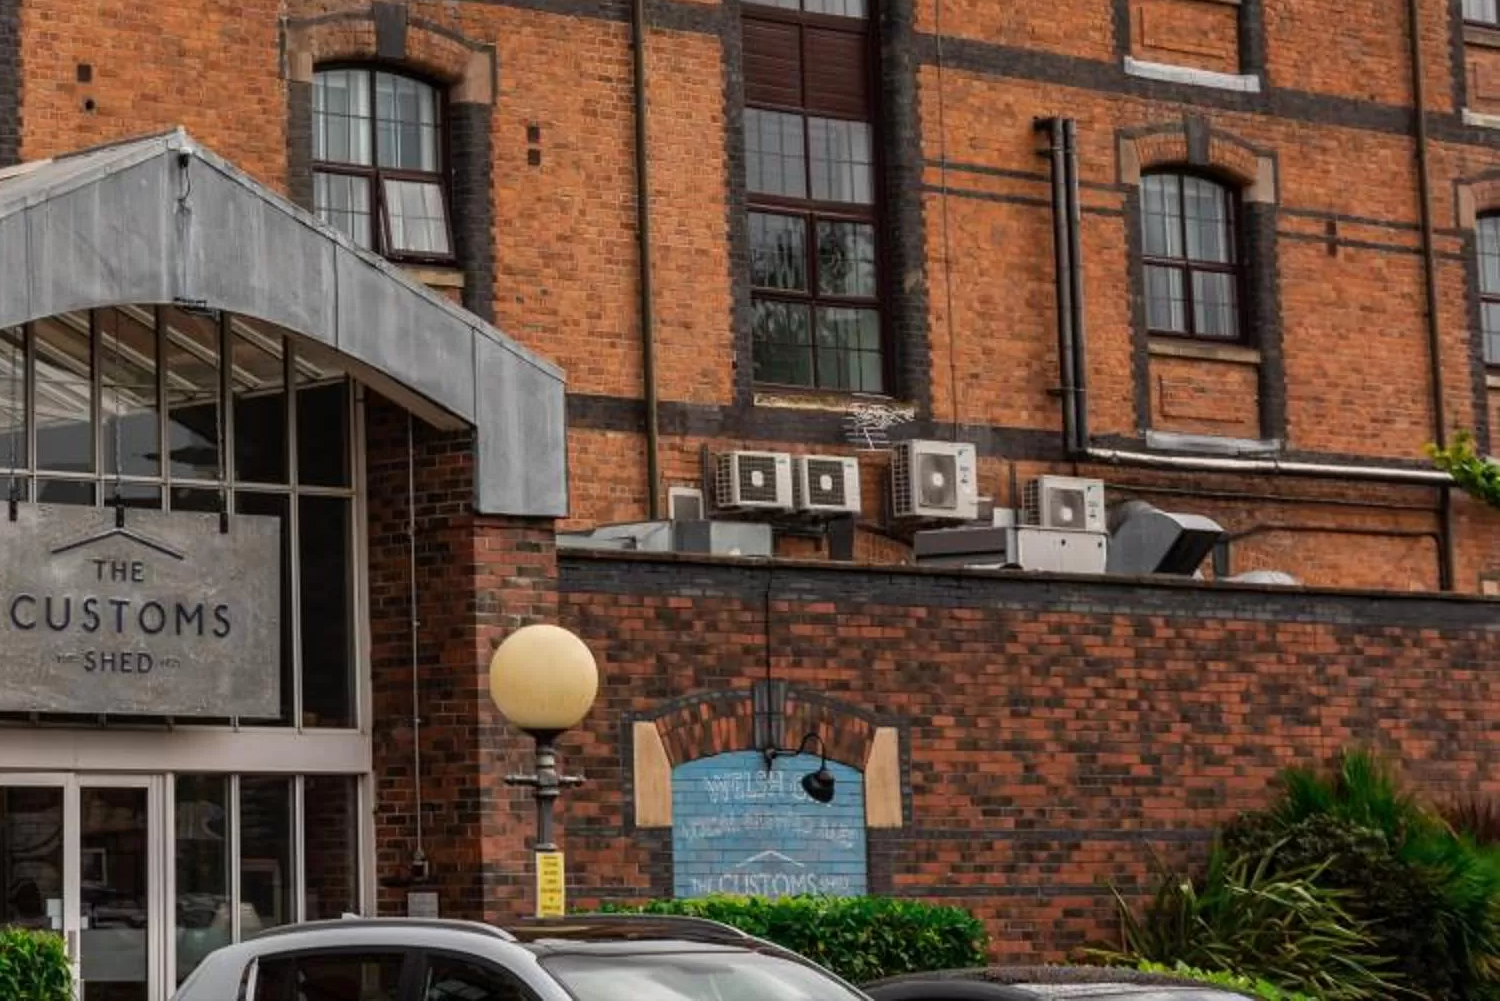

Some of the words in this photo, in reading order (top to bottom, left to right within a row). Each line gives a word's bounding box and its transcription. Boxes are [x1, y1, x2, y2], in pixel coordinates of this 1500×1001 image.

[92, 559, 145, 583] THE
[10, 595, 232, 638] CUSTOMS
[83, 651, 153, 674] SHED
[718, 872, 818, 896] CUSTOMS
